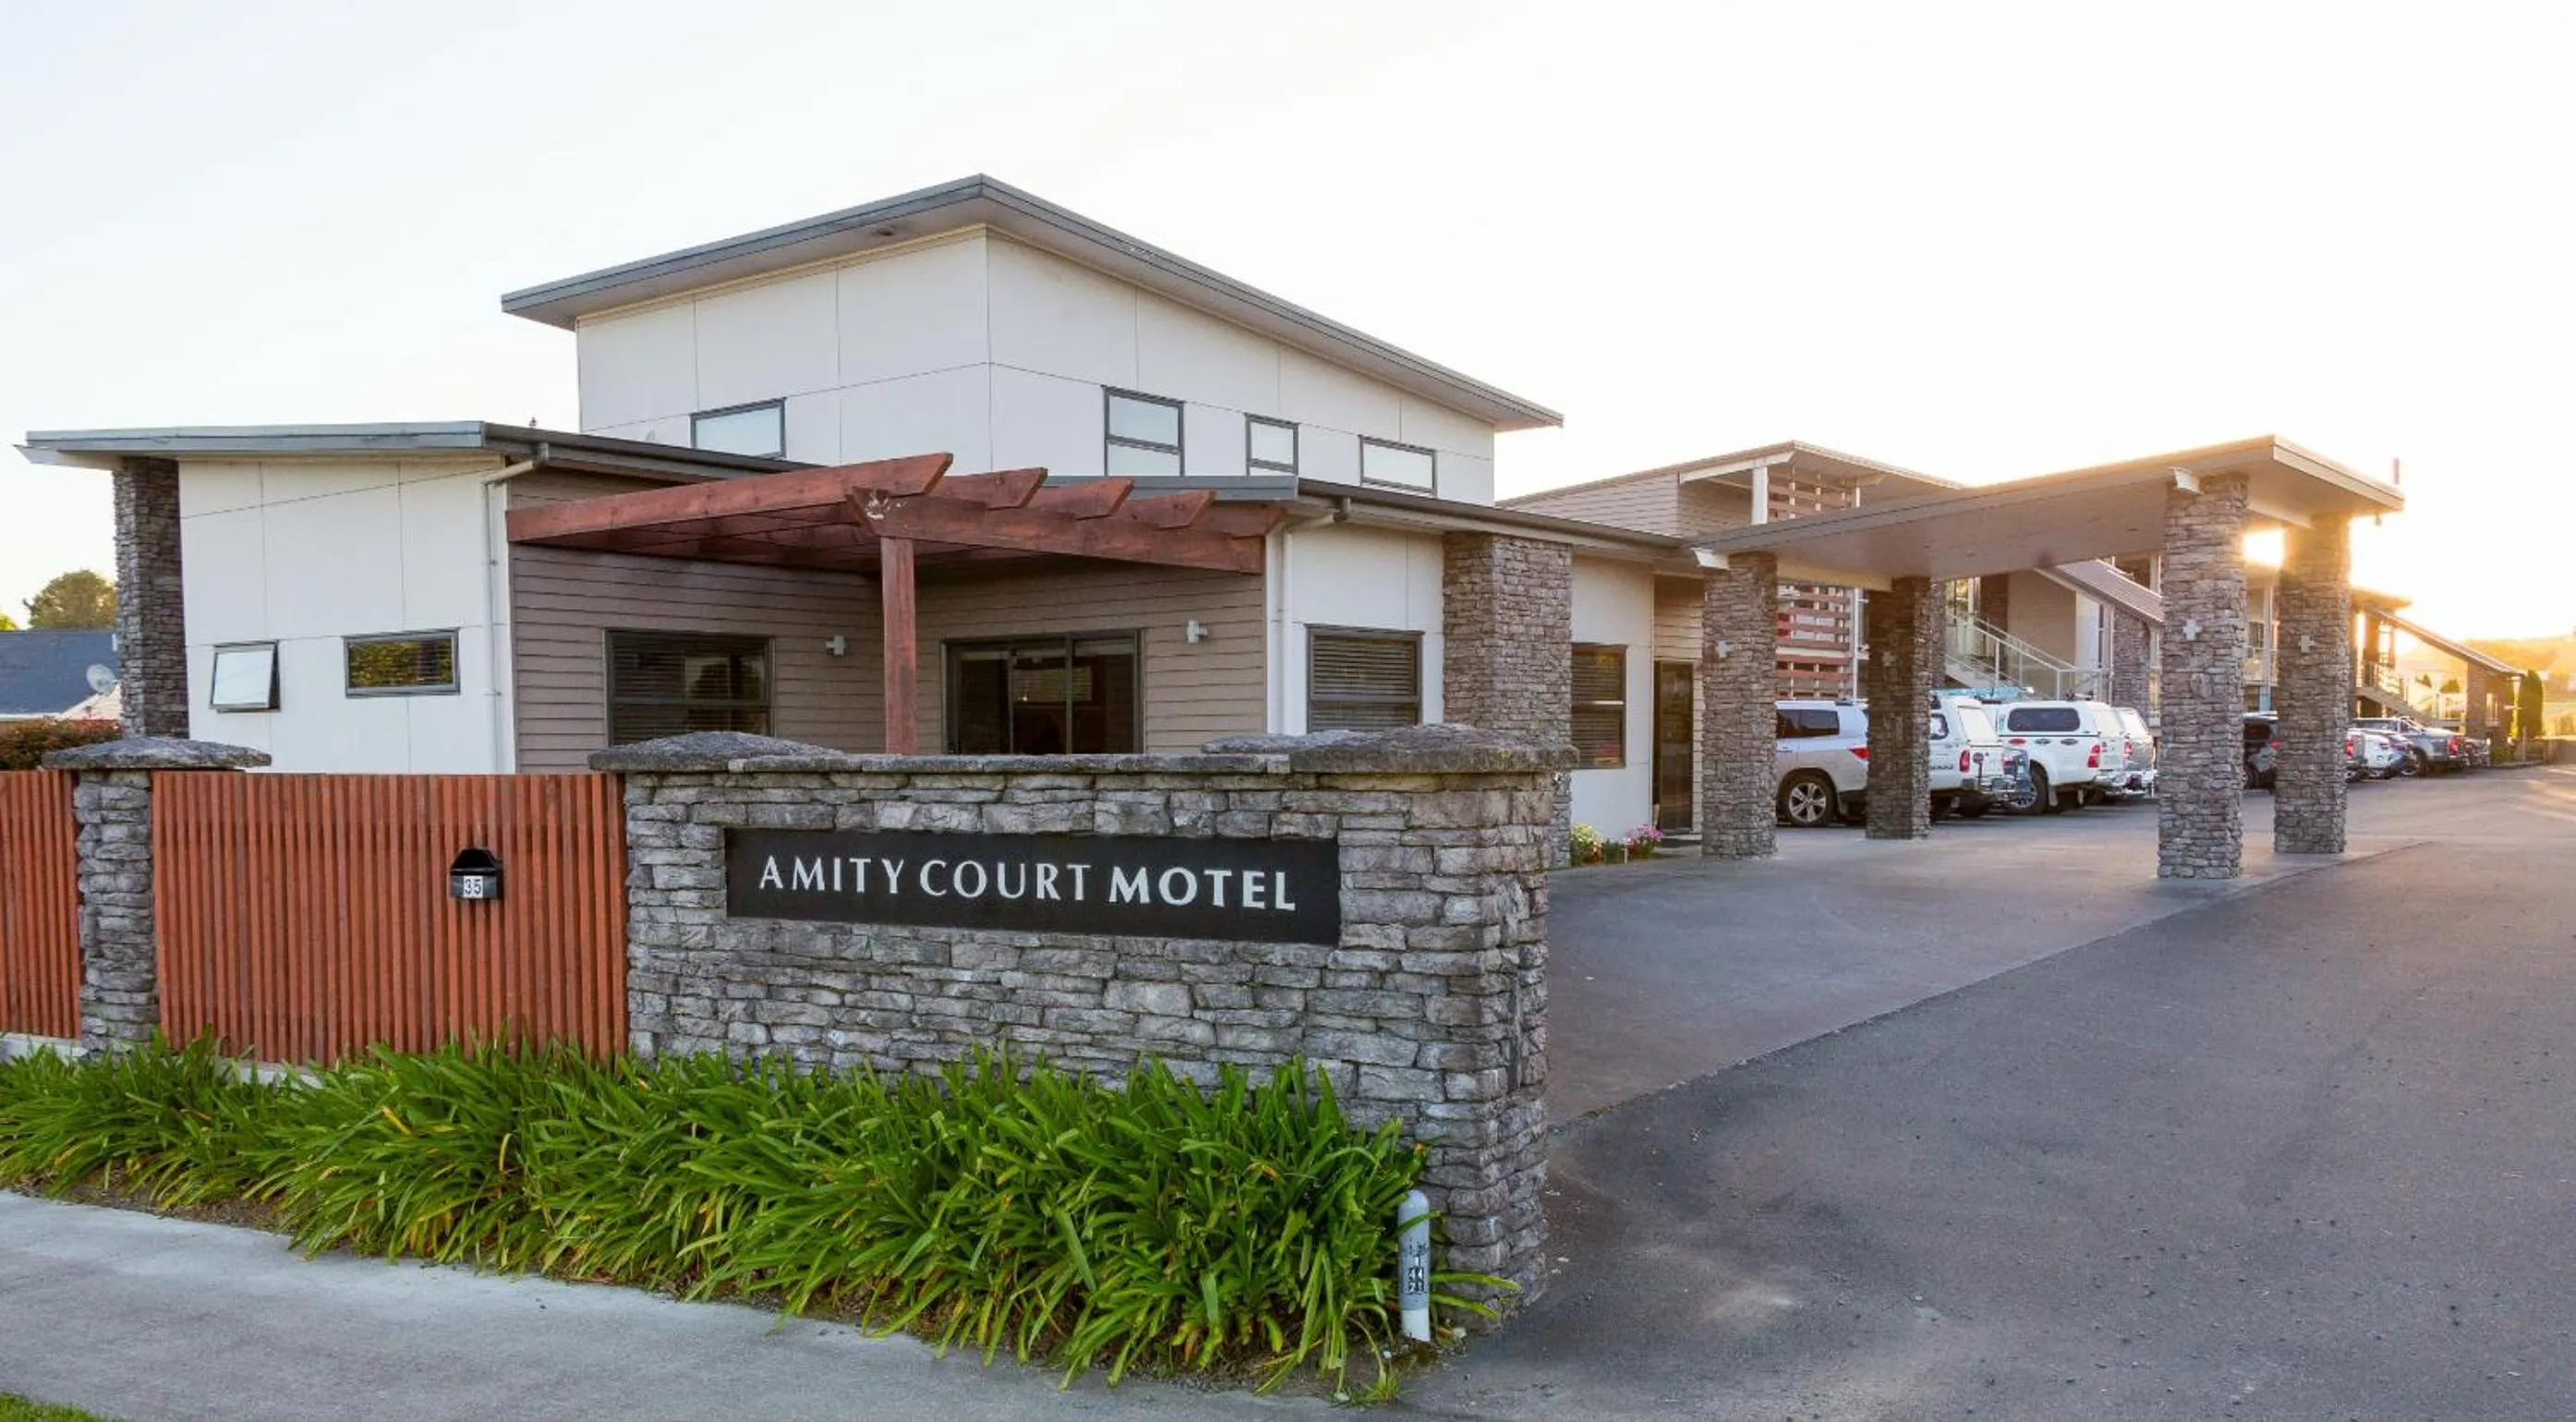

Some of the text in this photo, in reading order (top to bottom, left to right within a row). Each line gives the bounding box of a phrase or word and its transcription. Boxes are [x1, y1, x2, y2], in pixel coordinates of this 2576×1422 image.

[465, 878, 481, 895] 35
[758, 854, 1297, 911] AMITY COURT MOTEL
